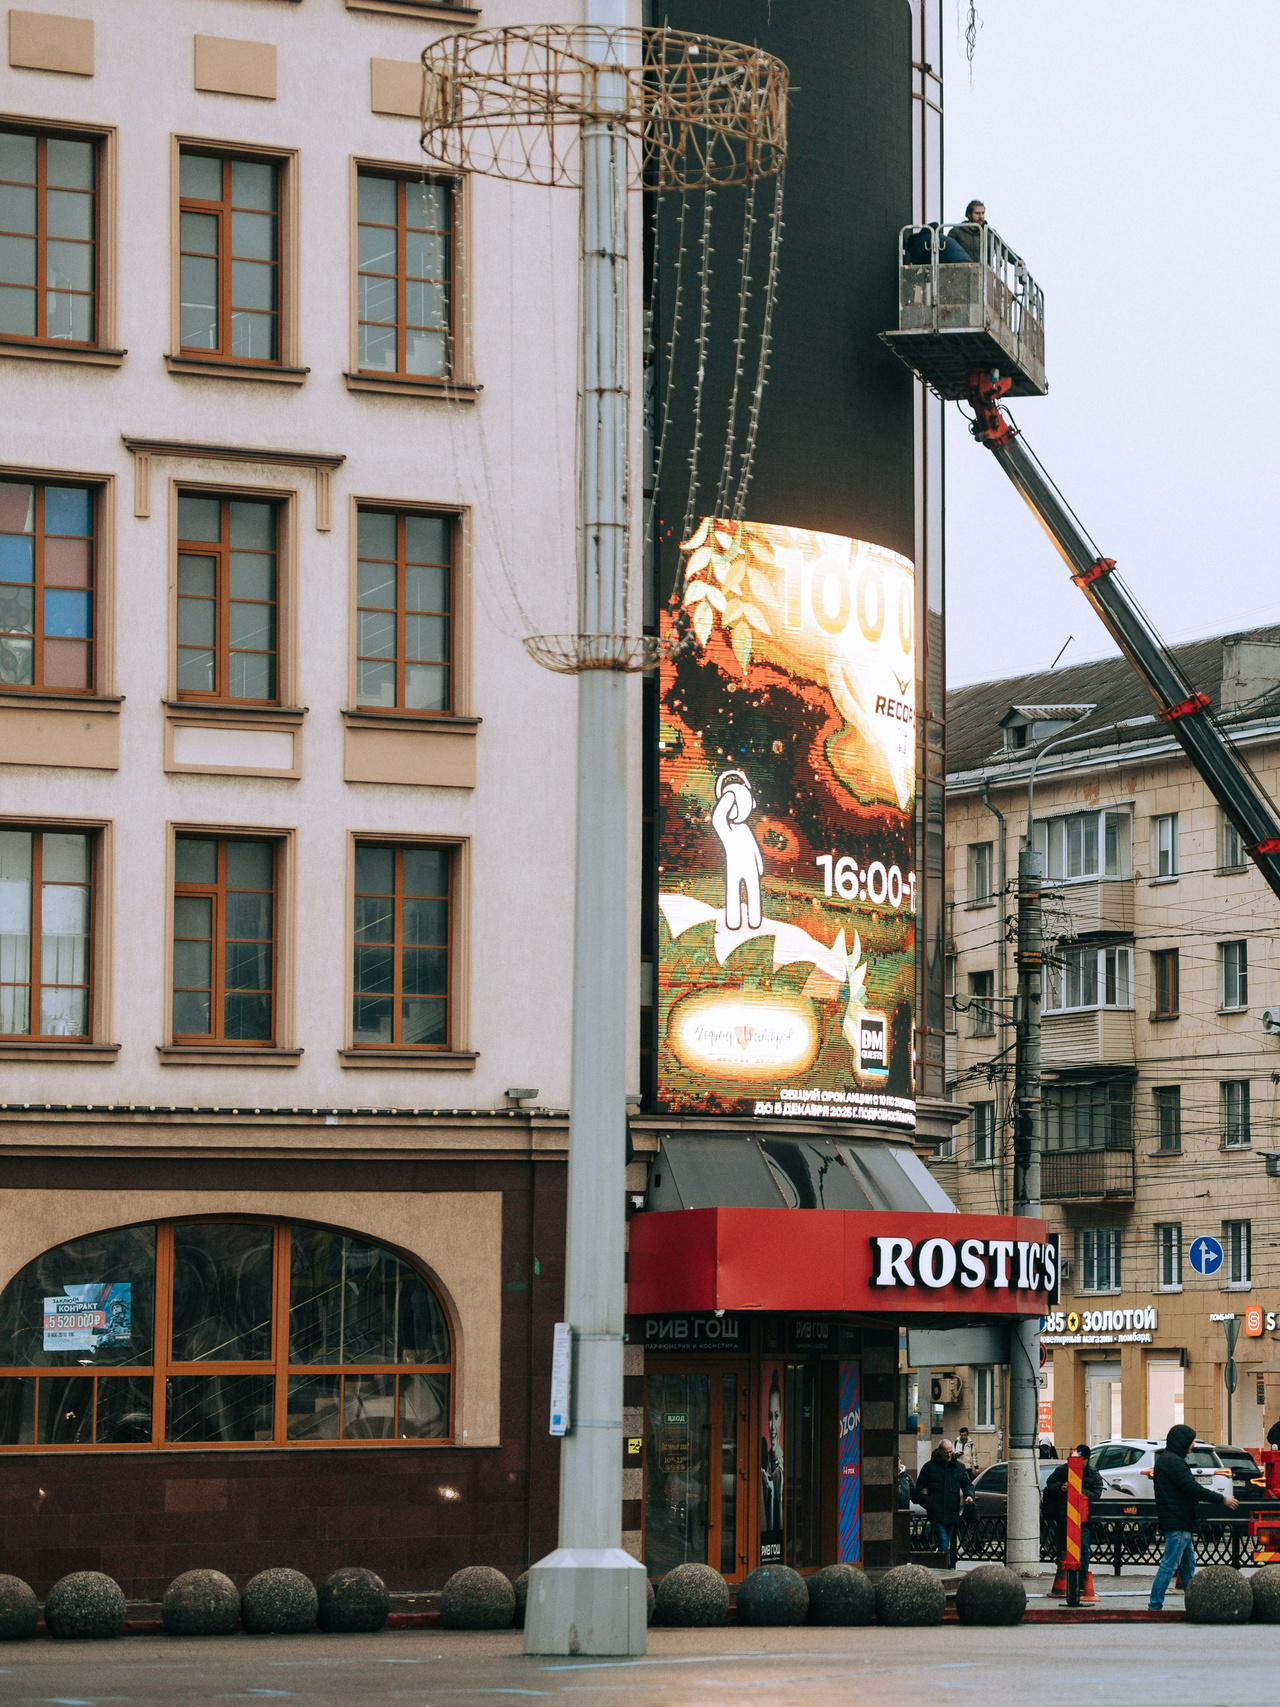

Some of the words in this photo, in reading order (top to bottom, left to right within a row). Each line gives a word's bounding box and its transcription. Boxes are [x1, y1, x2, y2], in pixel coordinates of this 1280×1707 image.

[875, 694, 916, 729] RECOR
[861, 1029, 883, 1051] DM
[861, 1050, 883, 1061] QUESTS
[780, 1088, 820, 1102] ОБЩИЙ
[754, 1101, 773, 1115] ДО
[783, 1103, 830, 1116] ДЕКАБРЯ
[873, 1236, 1056, 1292] ROSTIC'S
[58, 1303, 98, 1313] КОНТРАКТ
[49, 1316, 55, 1328] 5
[57, 1315, 75, 1328] 520
[1082, 1305, 1157, 1332] ЗОЛОТОЙ
[645, 1318, 689, 1339] РИВ
[693, 1318, 739, 1338] ГОШ
[1082, 1334, 1113, 1344] магазин
[1118, 1332, 1151, 1344] ломбард
